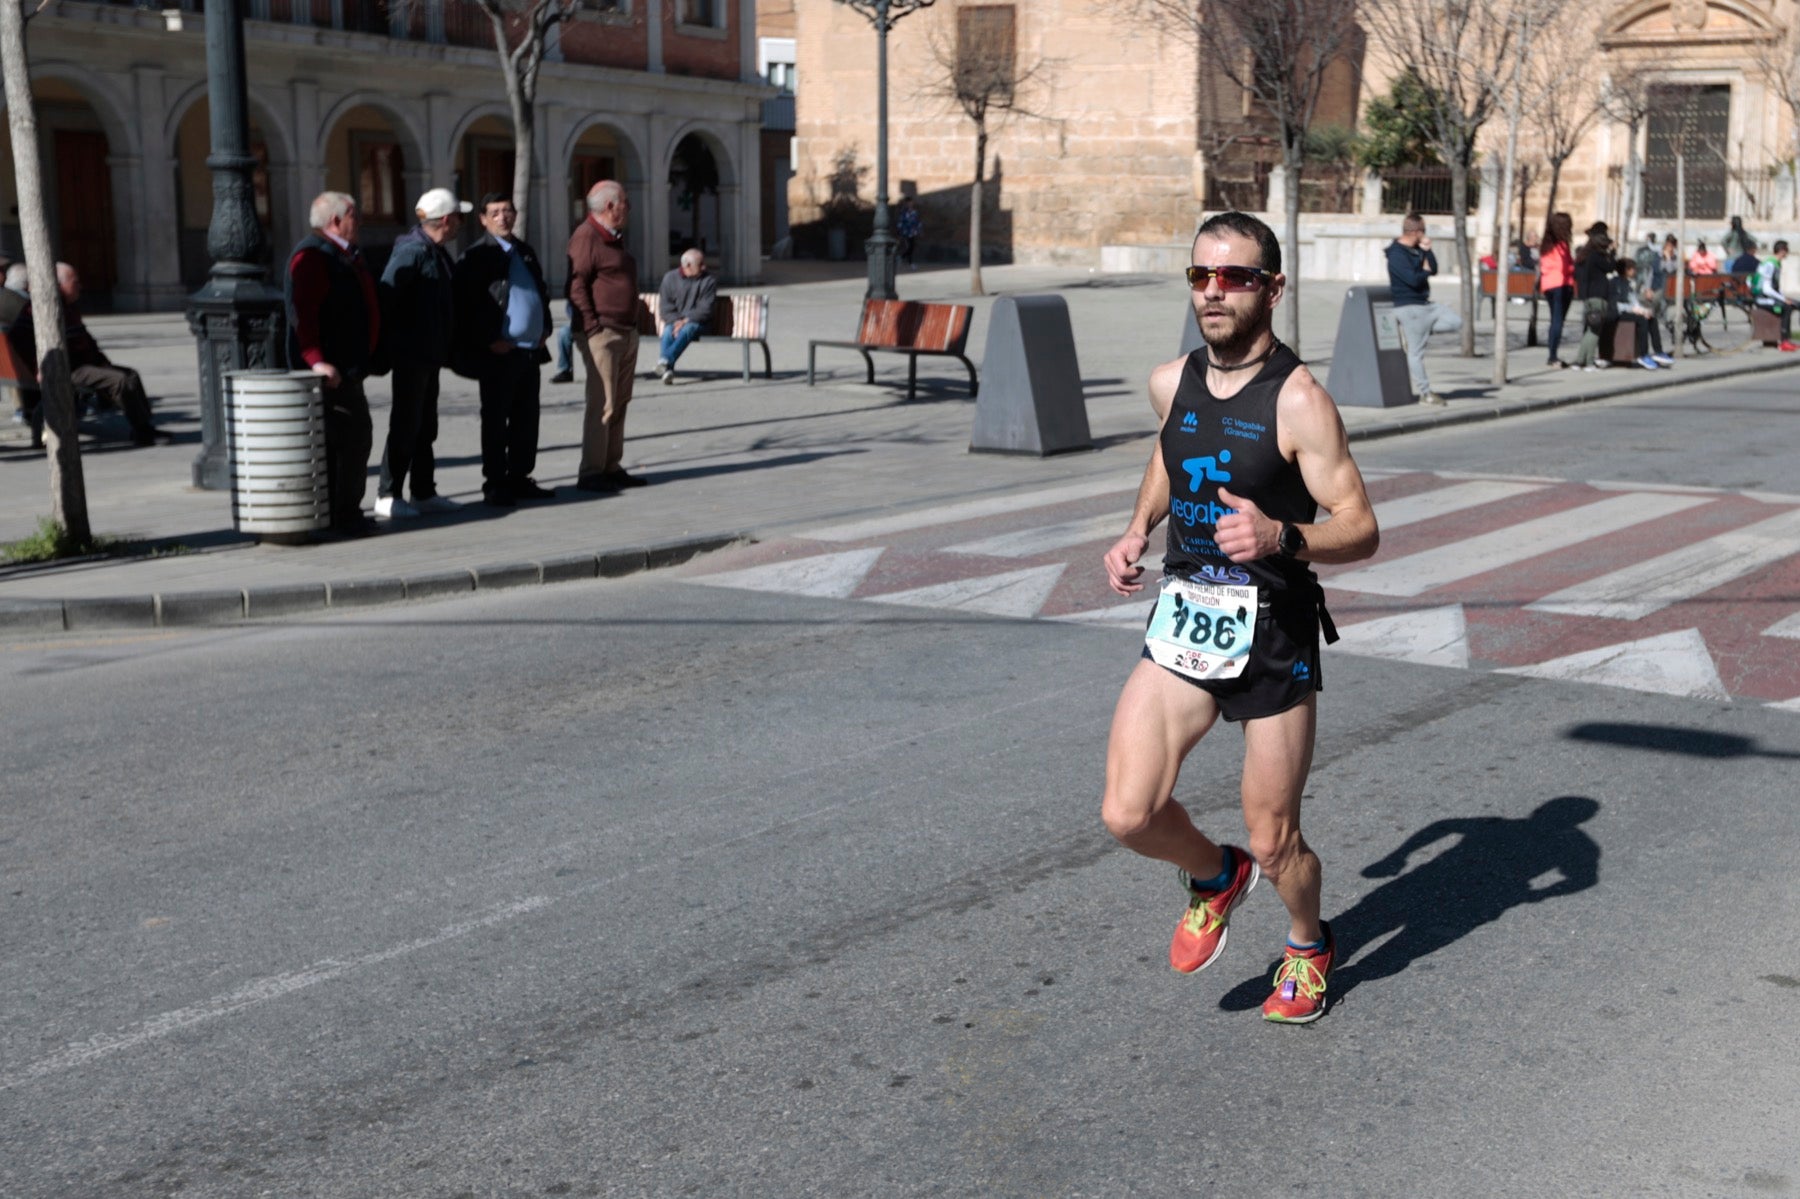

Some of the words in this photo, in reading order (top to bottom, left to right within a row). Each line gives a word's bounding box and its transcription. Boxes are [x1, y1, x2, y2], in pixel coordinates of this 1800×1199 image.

[1222, 417, 1233, 426] CC
[1235, 419, 1266, 432] Vegabike
[1224, 427, 1259, 441] (Granada)
[1171, 496, 1239, 527] vegab
[1217, 586, 1225, 597] DE
[1227, 588, 1250, 599] FONDO
[1172, 606, 1236, 651] 186
